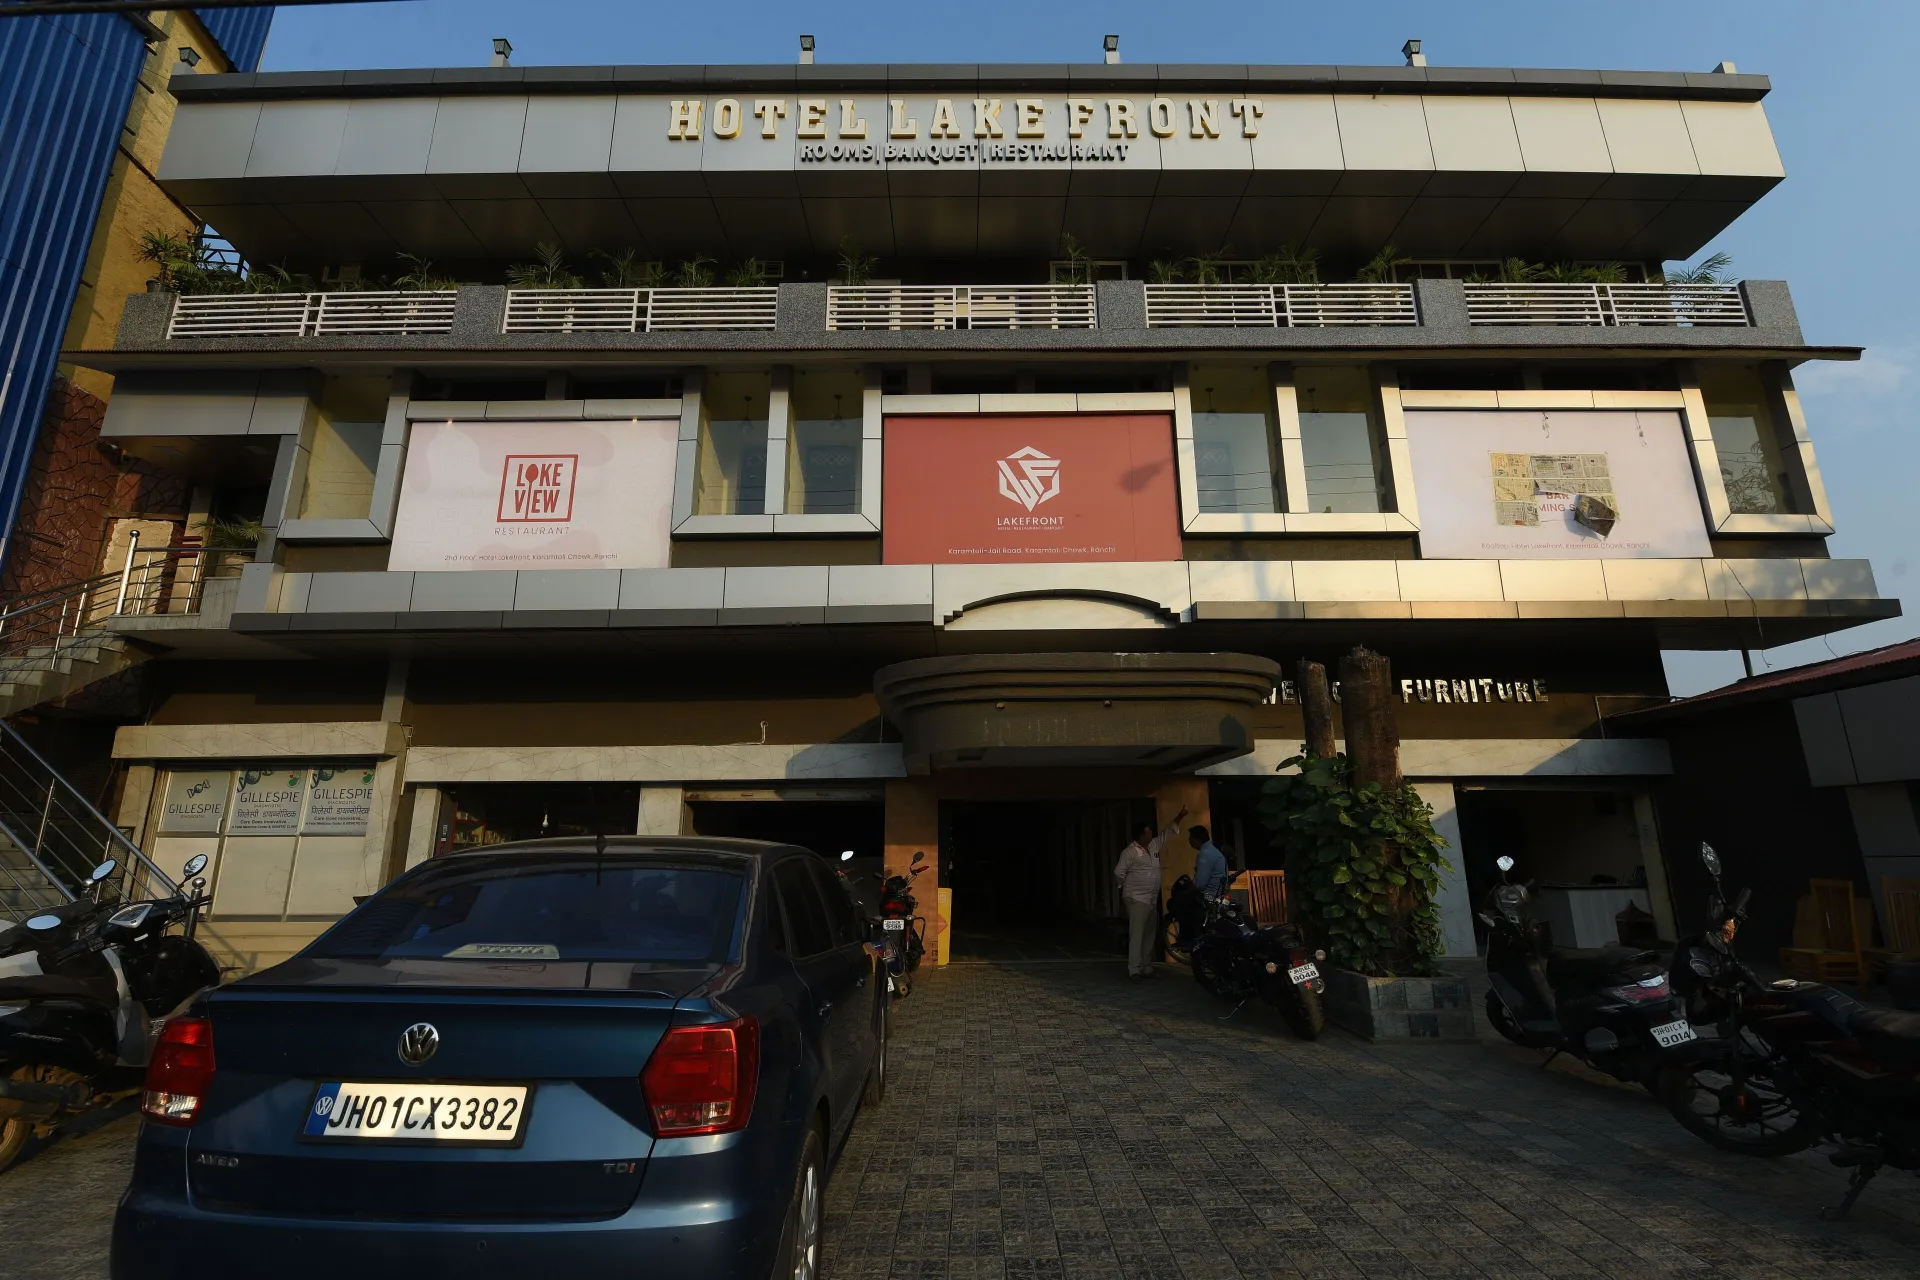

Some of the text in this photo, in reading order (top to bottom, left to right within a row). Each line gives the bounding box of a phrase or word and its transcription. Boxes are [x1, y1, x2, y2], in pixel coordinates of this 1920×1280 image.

[667, 96, 1265, 140] HOTEL LAKE FRONT
[514, 489, 560, 514] VIEW
[1538, 503, 1565, 512] MING
[996, 516, 1065, 526] LAKEFRONT
[494, 526, 571, 536] RESTAURANT
[1090, 545, 1117, 555] Ranchi
[1627, 541, 1651, 551] Ranchi
[444, 554, 458, 562] 2nd
[593, 551, 618, 561] Ranchi
[1400, 677, 1549, 705] FURNITURE
[240, 791, 300, 803] GILLESPIE
[313, 788, 374, 800] GILLESPIE
[168, 803, 222, 814] GILLESPIE
[327, 1093, 519, 1134] JH01CX3382
[603, 1162, 636, 1175] TDI
